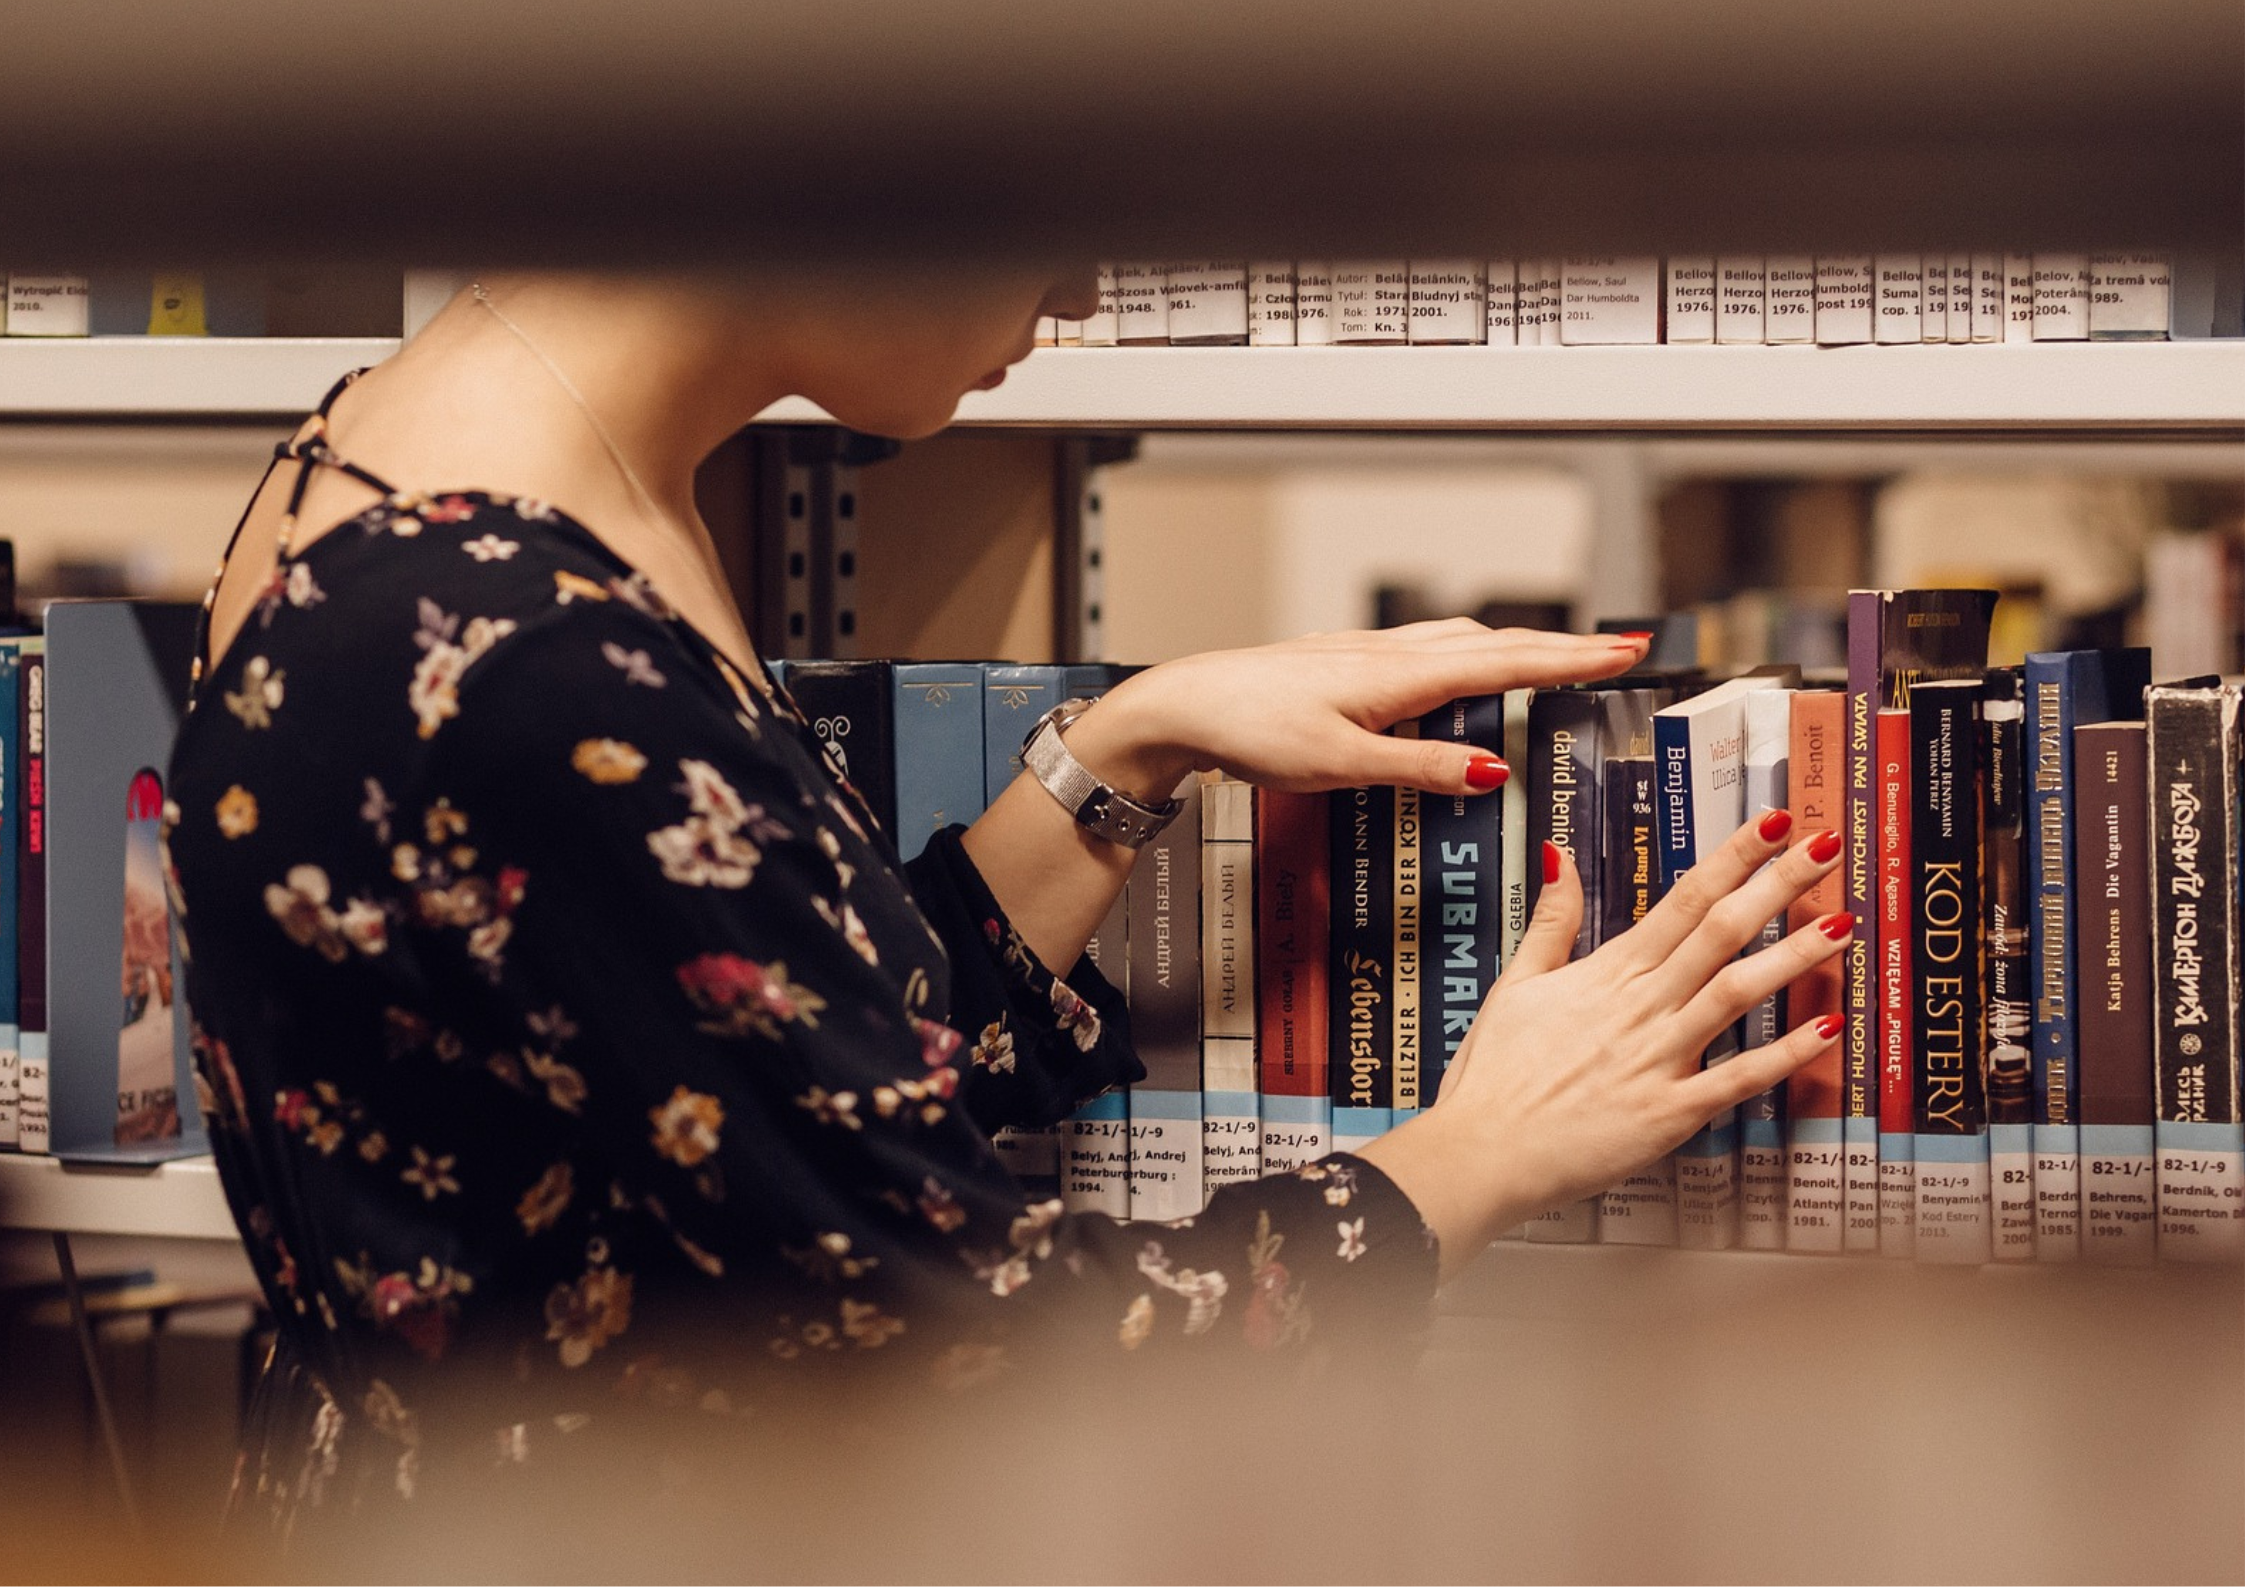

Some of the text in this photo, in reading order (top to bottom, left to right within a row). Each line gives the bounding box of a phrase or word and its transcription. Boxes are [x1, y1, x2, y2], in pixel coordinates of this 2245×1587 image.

[1567, 277, 1627, 288] Bellow, Saul
[2034, 272, 2073, 284] Belov,
[2106, 274, 2145, 286] tremâ
[1118, 287, 1155, 298] Szosa
[1337, 292, 1368, 303] Tytuł:
[1411, 290, 1460, 303] Bludnyj
[1567, 293, 1640, 303] Dar Humboldta
[1882, 289, 1919, 299] Suma
[13, 302, 43, 311] 2010.
[1118, 303, 1155, 314] 1948.
[1411, 307, 1448, 318] 2001.
[1676, 302, 1714, 313] 1976.
[1724, 304, 1761, 315] 1976.
[1773, 304, 1810, 315] 1976.
[1817, 300, 1846, 312] post
[1882, 306, 1909, 317] cop.
[2034, 305, 2071, 316] 2004.
[1343, 309, 1368, 318] Rok:
[1567, 311, 1594, 320] 2011.
[1341, 324, 1368, 333] Tom:
[1374, 324, 1396, 333] Kn.
[1851, 691, 1868, 751] ŚWIATA
[1551, 730, 1577, 784] david
[1709, 738, 1742, 763] Walter
[1803, 724, 1824, 819] P. Benoit
[1853, 755, 1868, 789] PAN
[1664, 746, 1690, 850] Benjamin
[1633, 803, 1652, 815] 936
[1632, 826, 1650, 838] VI
[1884, 762, 1901, 922] G. Benusiglio, R. Agasso
[1853, 797, 1868, 901] ANTYCHRYST
[1632, 846, 1649, 884] Band
[1397, 858, 1417, 895] DER
[2105, 750, 2124, 1012] Katja Behrens Die Vagantin 14421
[1509, 881, 1525, 931] GŁĘBIA
[1153, 847, 1172, 989] АНДРЕЙ БЕЛЫЙ
[1397, 905, 1417, 941] BIN
[1220, 864, 1237, 1014] АНДРЕЙ БЕЛЫЙ
[1397, 951, 1417, 983] ICH
[1886, 937, 1902, 1008] WZIĘŁAM
[1852, 939, 1866, 1009] BENSON
[1994, 960, 2008, 994] żona
[1923, 860, 1965, 1132] KOD ESTERY
[1345, 949, 1383, 1108] Lebensbor
[1397, 1007, 1417, 1097] BELZNER
[1852, 1013, 1866, 1079] HUGON
[1203, 1122, 1256, 1135] 82-1/-9
[1265, 1134, 1319, 1148] 82-1/-9
[1145, 1150, 1187, 1163] Andrej
[1203, 1146, 1235, 1158] Belyj,
[1264, 1158, 1296, 1170] Belyj,
[2164, 1158, 2226, 1174] 82-1/-9
[1070, 1183, 1104, 1193] 1994.
[1793, 1177, 1840, 1191] Benoit,
[1921, 1177, 1970, 1188] 82-1/-9
[2163, 1184, 2219, 1198] Berdnik,
[2090, 1192, 2147, 1205] Behrens,
[1602, 1206, 1631, 1217] 1991
[1849, 1201, 1873, 1211] Pan
[2162, 1205, 2228, 1220] Kamerton
[1921, 1212, 1980, 1224] Kod Estery
[2090, 1209, 2111, 1220] Die
[1793, 1216, 1830, 1227] 1981.
[2040, 1225, 2077, 1236] 1985.
